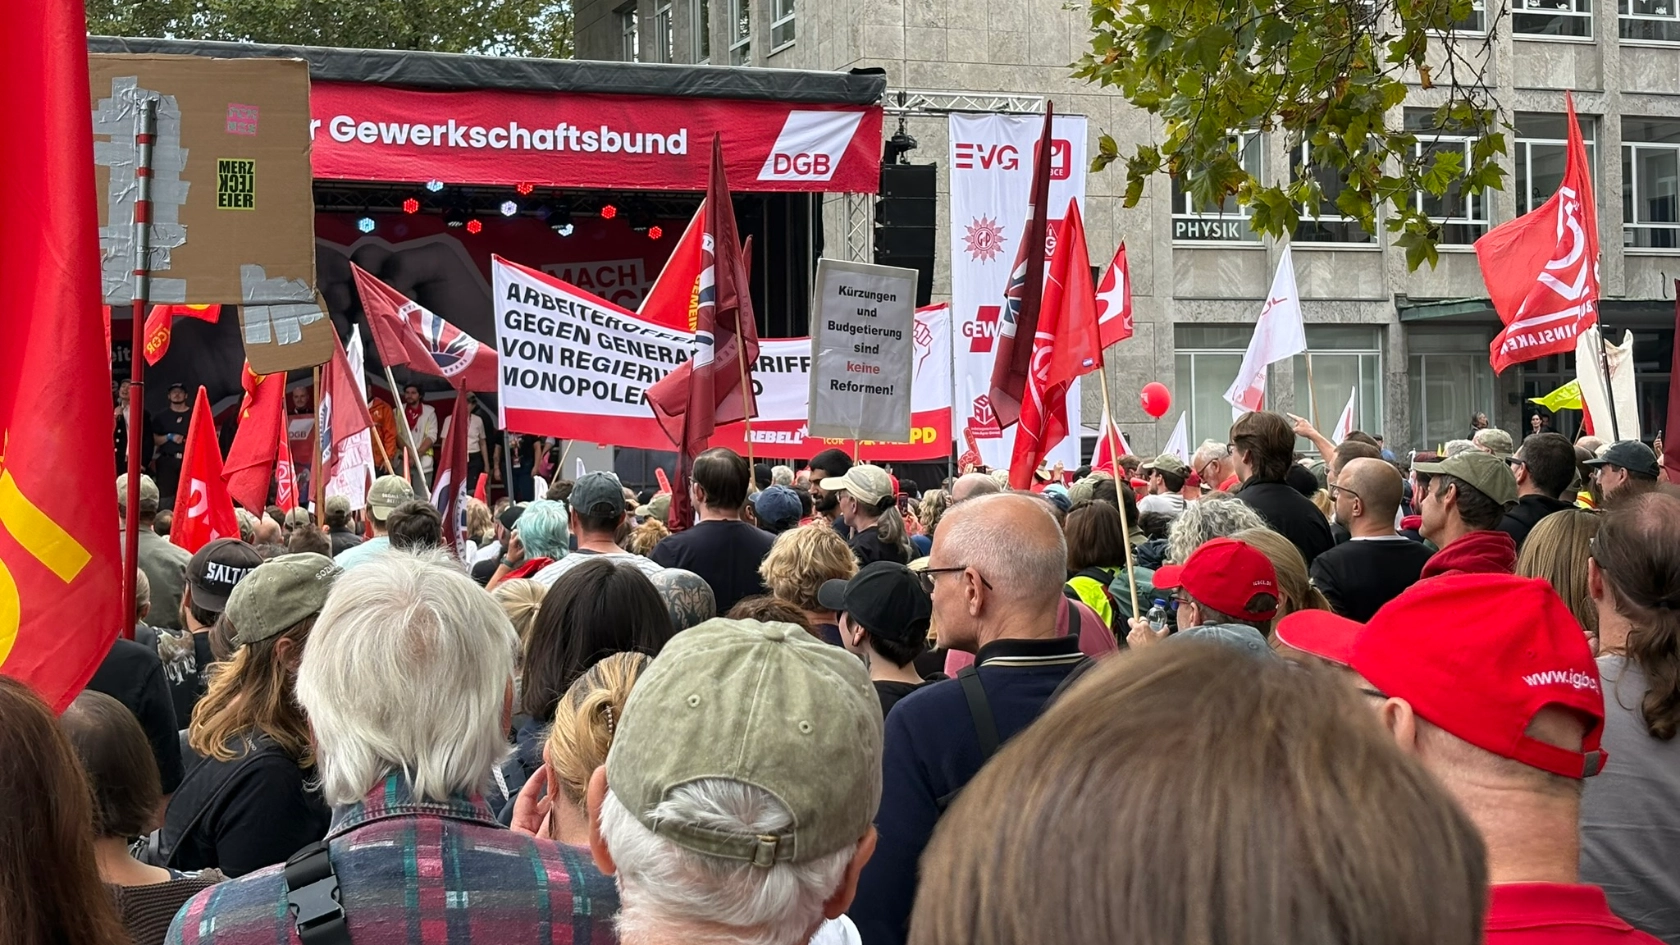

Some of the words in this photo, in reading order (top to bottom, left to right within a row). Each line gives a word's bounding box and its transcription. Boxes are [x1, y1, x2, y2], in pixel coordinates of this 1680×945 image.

[329, 114, 687, 155] Gewerkschaftsbund
[773, 152, 831, 176] DGB
[955, 143, 1019, 171] EVG
[218, 160, 254, 175] MERZ
[218, 192, 254, 208] EIER
[1175, 221, 1240, 238] PHYSIK
[547, 264, 637, 289] MACH
[838, 285, 897, 303] Kürzungen
[857, 307, 877, 318] und
[504, 309, 591, 346] GEGEN
[597, 331, 699, 366] GENERA
[827, 320, 902, 341] Budgetierung
[501, 336, 554, 365] VON
[854, 342, 880, 355] sind
[846, 361, 881, 375] keine
[830, 379, 894, 396] Reformen!
[207, 561, 254, 585] SALTA
